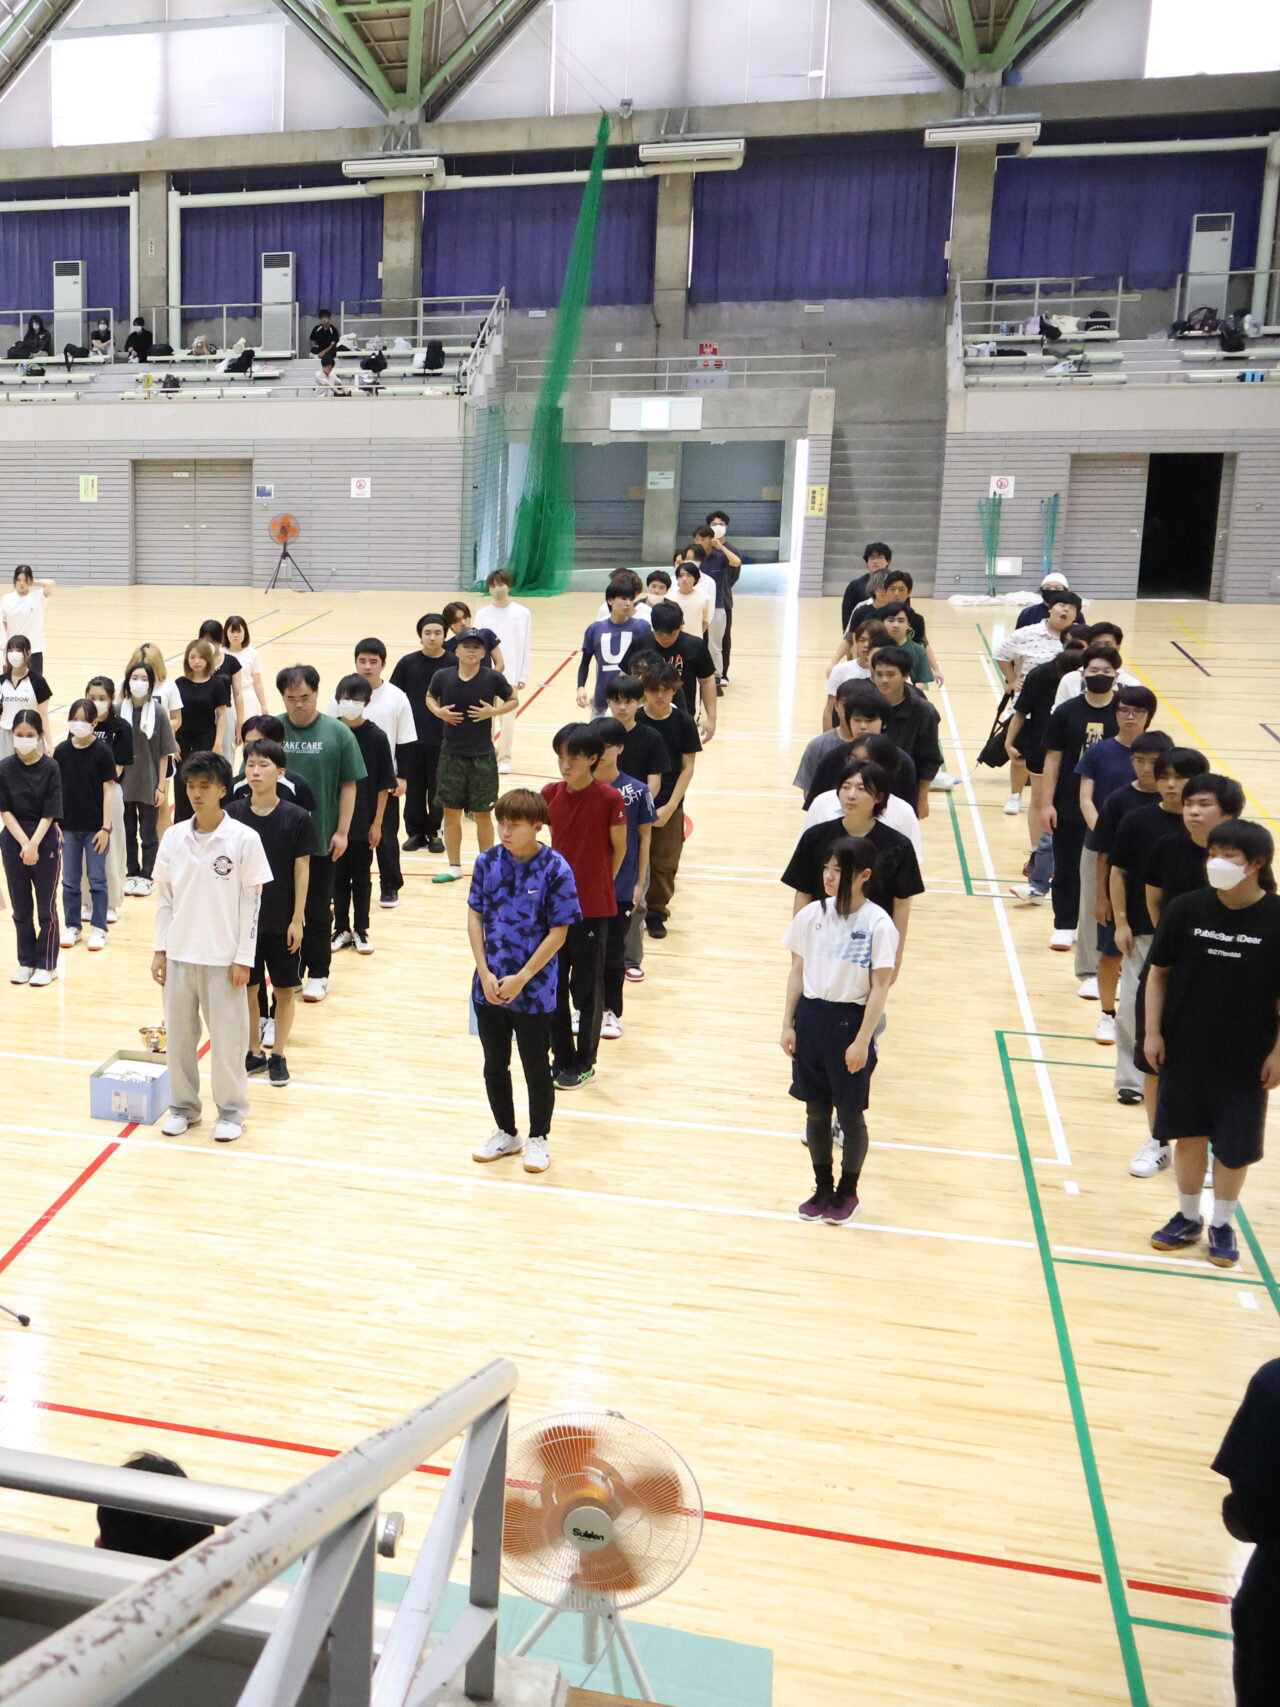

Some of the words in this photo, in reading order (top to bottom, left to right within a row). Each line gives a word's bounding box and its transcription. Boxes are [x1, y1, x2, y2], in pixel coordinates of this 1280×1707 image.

[600, 631, 633, 665] U
[300, 740, 323, 750] CARE
[622, 788, 644, 806] ORT
